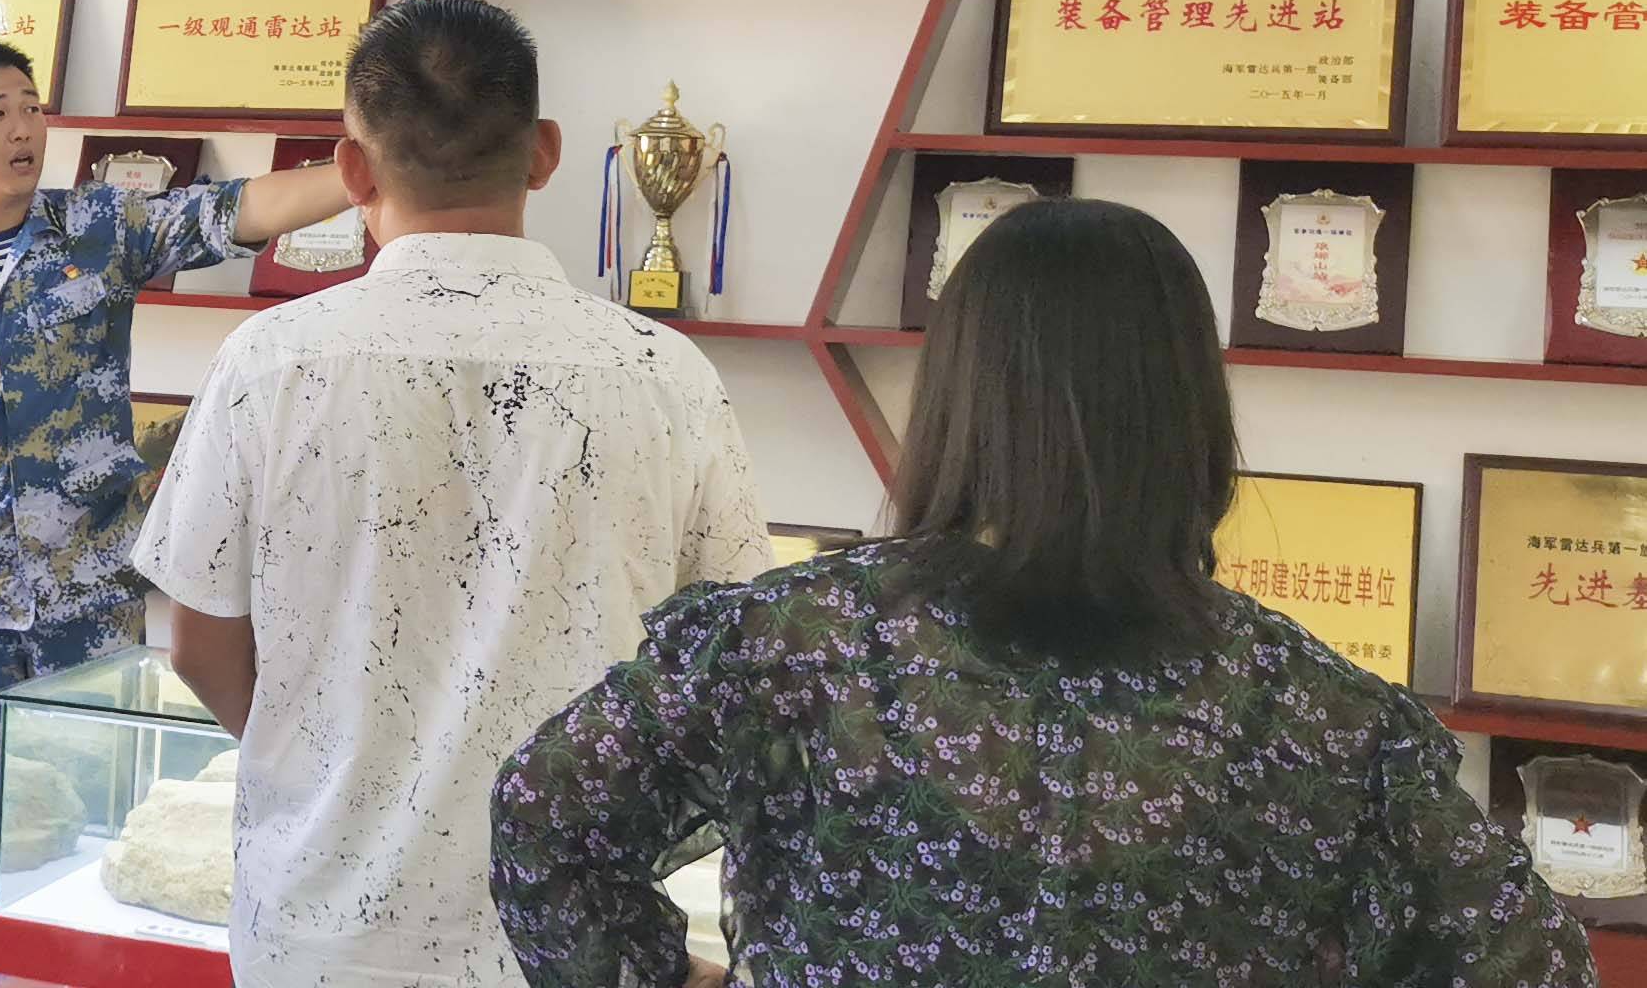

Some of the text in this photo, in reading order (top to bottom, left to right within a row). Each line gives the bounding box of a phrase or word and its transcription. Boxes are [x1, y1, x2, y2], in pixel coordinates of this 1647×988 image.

[157, 15, 343, 39] 一级观通雷达站
[1499, 0, 1647, 30] 装备管
[1528, 562, 1647, 610] 先进基
